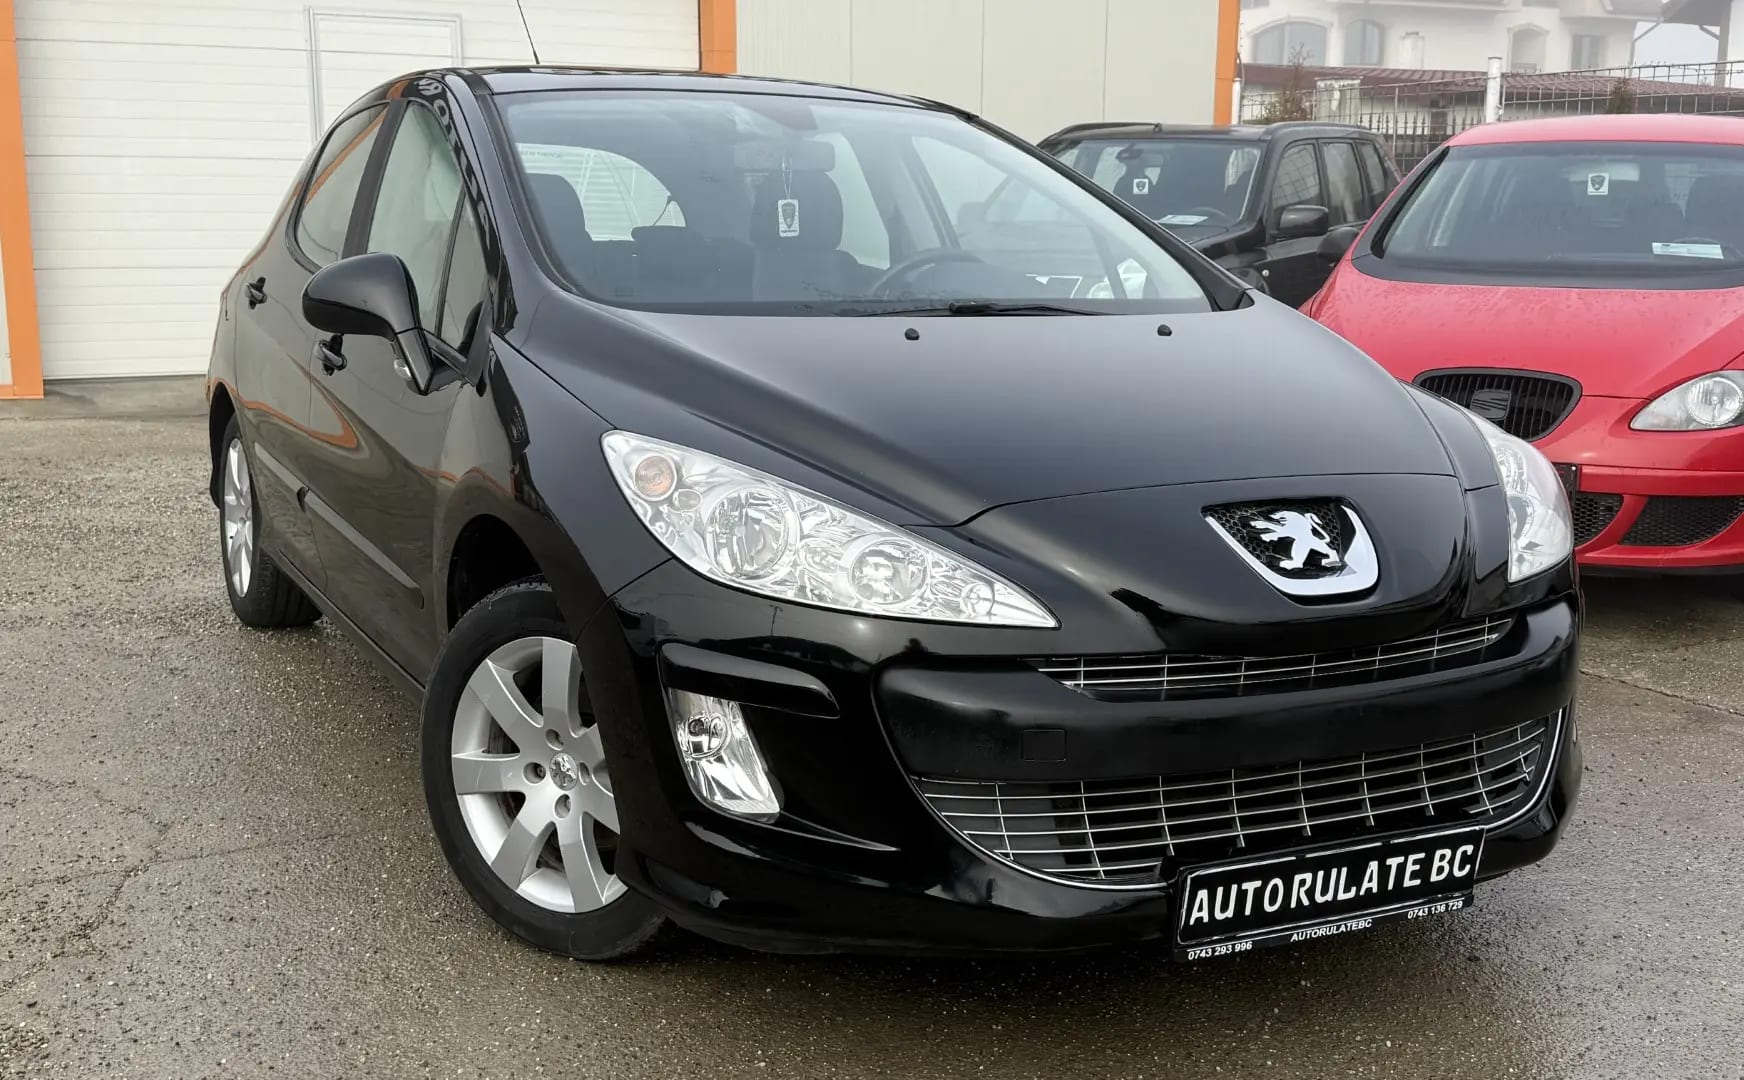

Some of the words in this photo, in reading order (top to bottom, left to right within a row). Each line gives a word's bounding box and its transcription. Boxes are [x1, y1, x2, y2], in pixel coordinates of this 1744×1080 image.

[1429, 844, 1474, 883] BC
[1407, 908, 1429, 919] 0743
[1431, 904, 1446, 914] 136
[1447, 901, 1463, 912] 729
[1290, 919, 1373, 942] AUTORULATEBC
[1188, 948, 1212, 960] 0743
[1214, 944, 1232, 955] 293
[1234, 941, 1253, 952] 996
